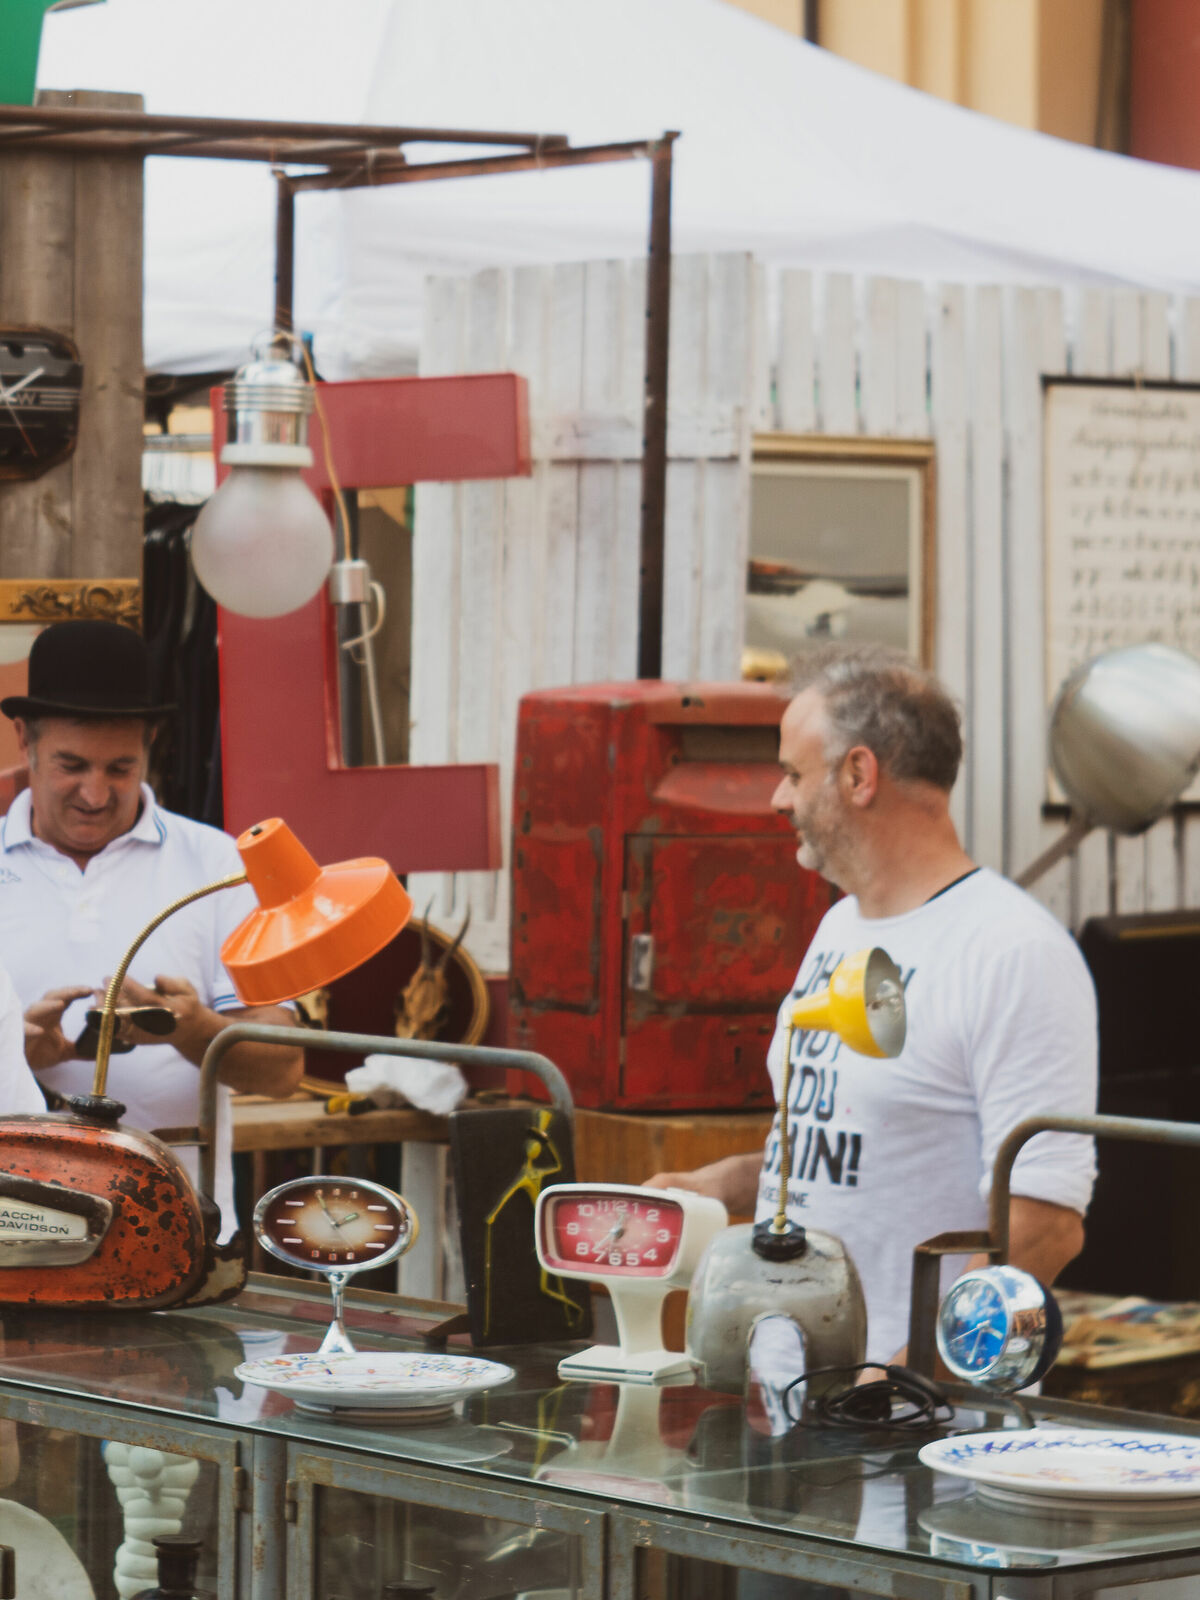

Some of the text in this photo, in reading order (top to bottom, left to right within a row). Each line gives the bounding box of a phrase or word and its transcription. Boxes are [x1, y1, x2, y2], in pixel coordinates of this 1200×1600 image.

[577, 1204, 593, 1217] 10
[612, 1200, 627, 1213] 12
[646, 1209, 660, 1222] 2
[566, 1222, 580, 1235] 9
[656, 1229, 670, 1243] 3
[576, 1242, 589, 1255] 8
[643, 1249, 658, 1261] 4
[608, 1253, 622, 1266] 6
[626, 1253, 640, 1266] 5
